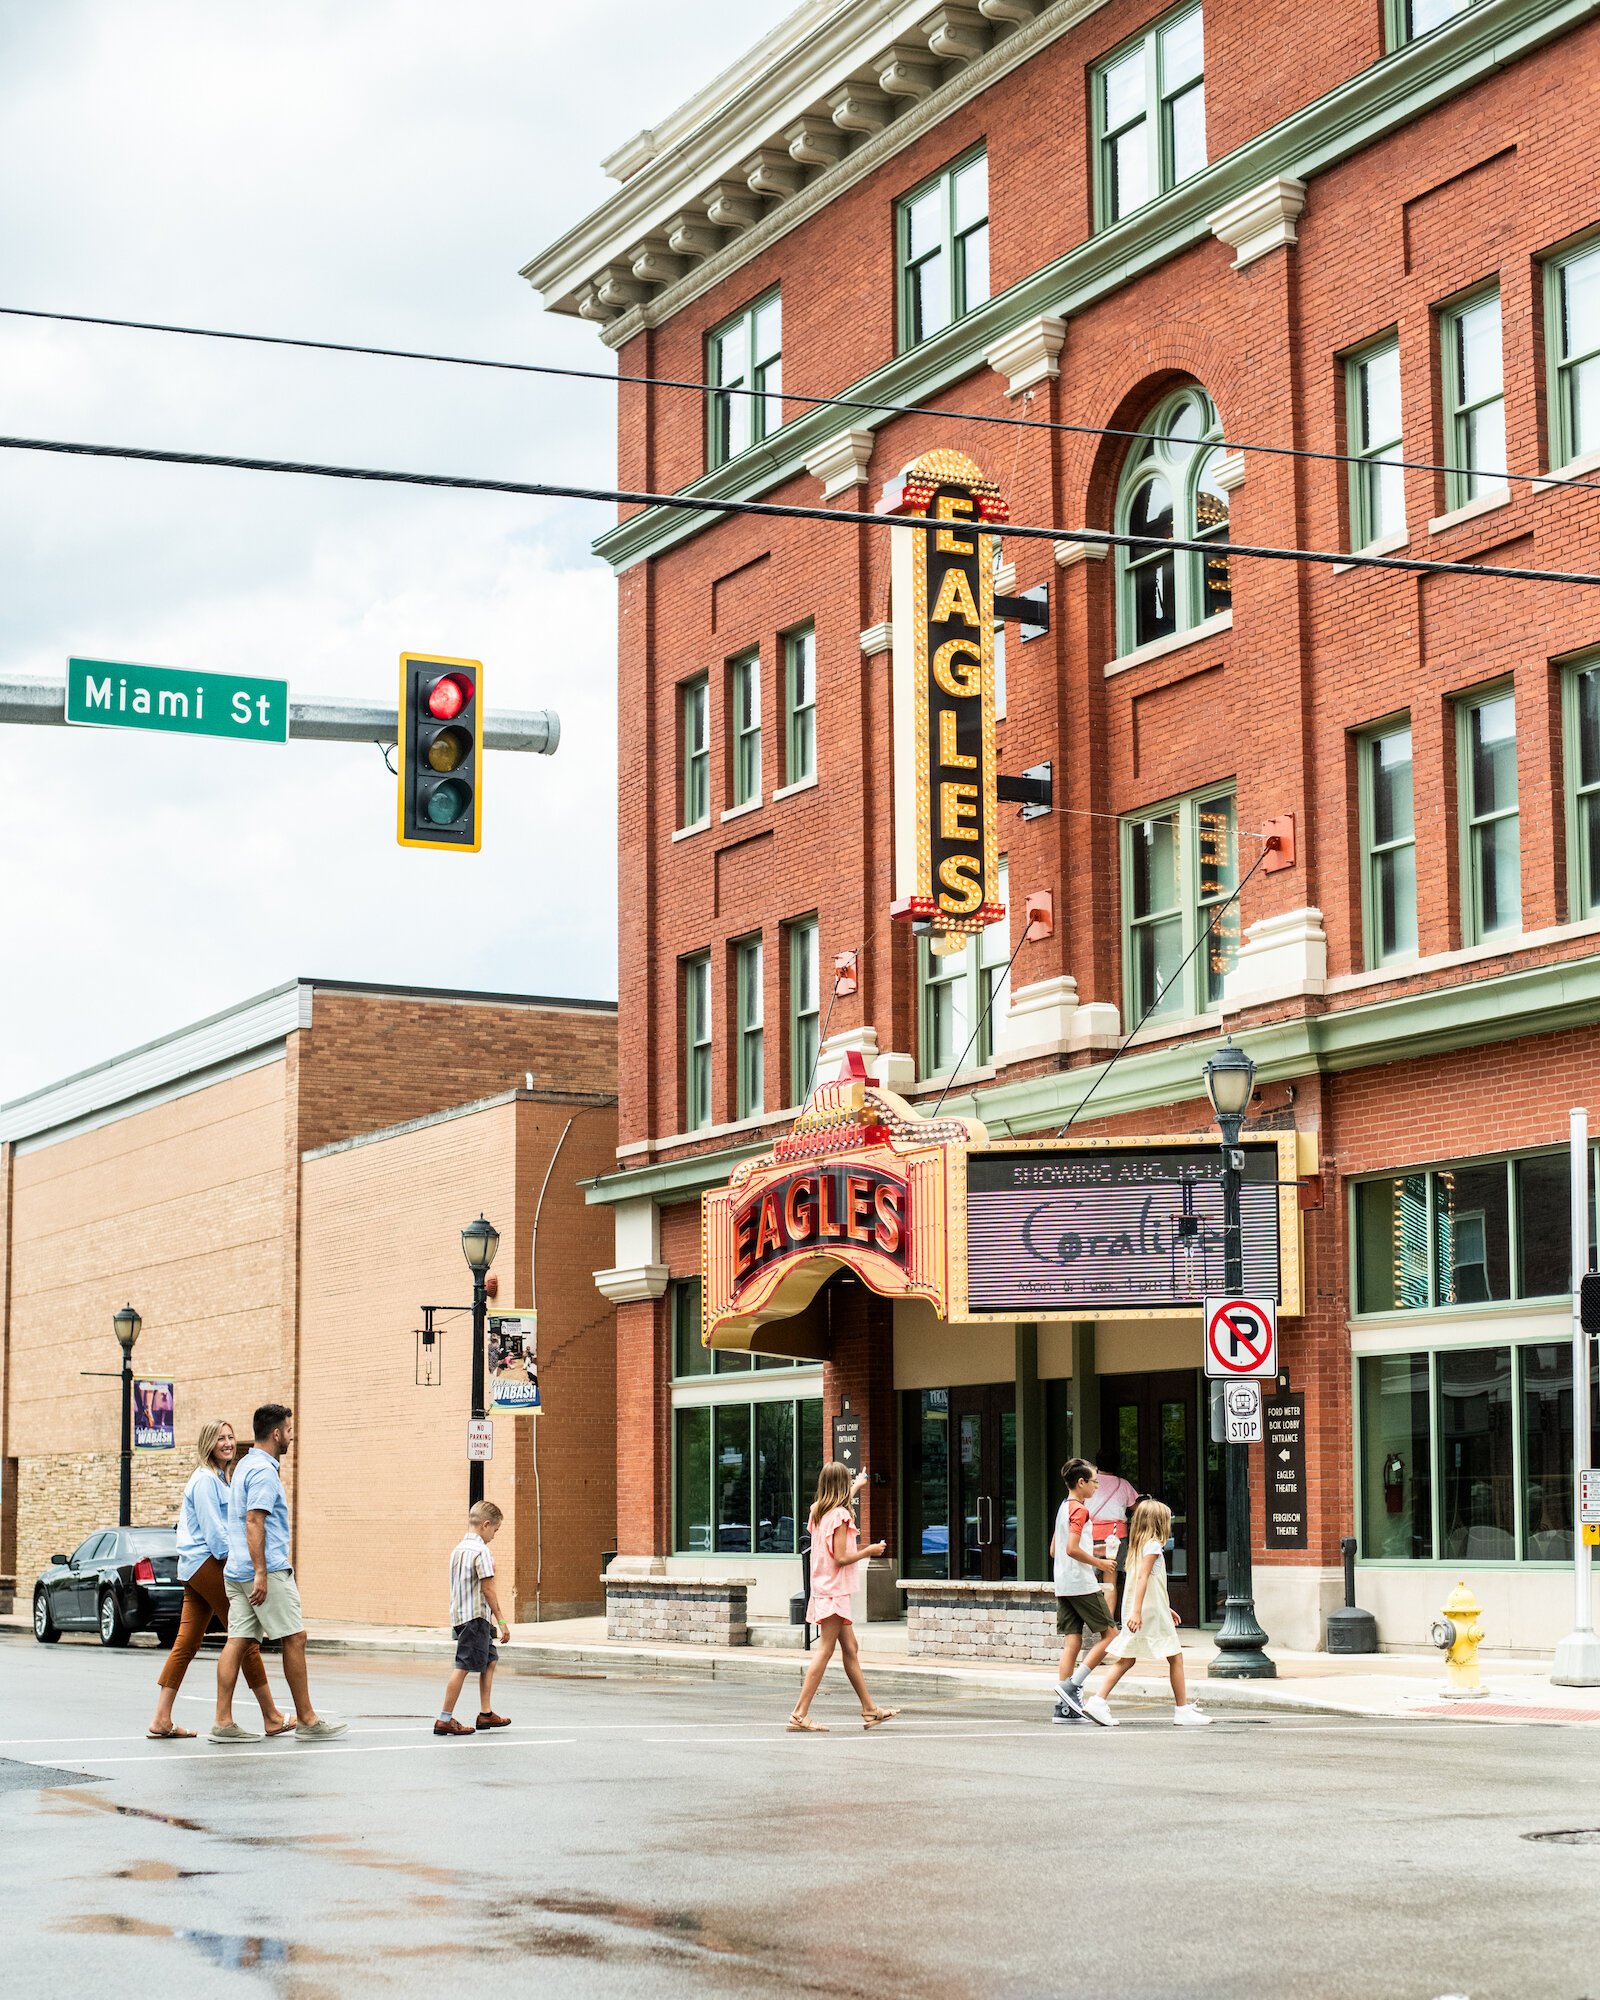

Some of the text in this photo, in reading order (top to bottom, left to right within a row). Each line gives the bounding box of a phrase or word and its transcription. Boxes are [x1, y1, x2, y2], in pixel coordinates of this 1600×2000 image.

[85, 675, 271, 727] Miami St
[930, 496, 983, 914] EAGLES
[1013, 1164, 1112, 1184] SHOWING
[733, 1174, 904, 1281] EAGLES
[494, 1385, 537, 1400] WABASH
[1268, 1407, 1283, 1417] FORD
[476, 1424, 485, 1432] NO
[836, 1423, 859, 1432] WEST LOBBY
[1231, 1421, 1257, 1438] STOP
[1269, 1420, 1300, 1430] BOX LOBBY
[138, 1431, 172, 1444] WABASH
[469, 1433, 491, 1441] PARKING
[838, 1434, 857, 1444] ENTRANCE
[1271, 1433, 1299, 1444] ENTRANCE
[1276, 1470, 1295, 1480] EAGLES
[1275, 1483, 1298, 1493] THEATRE
[1272, 1513, 1301, 1523] FERGUSON
[1275, 1526, 1299, 1536] THEATRE
